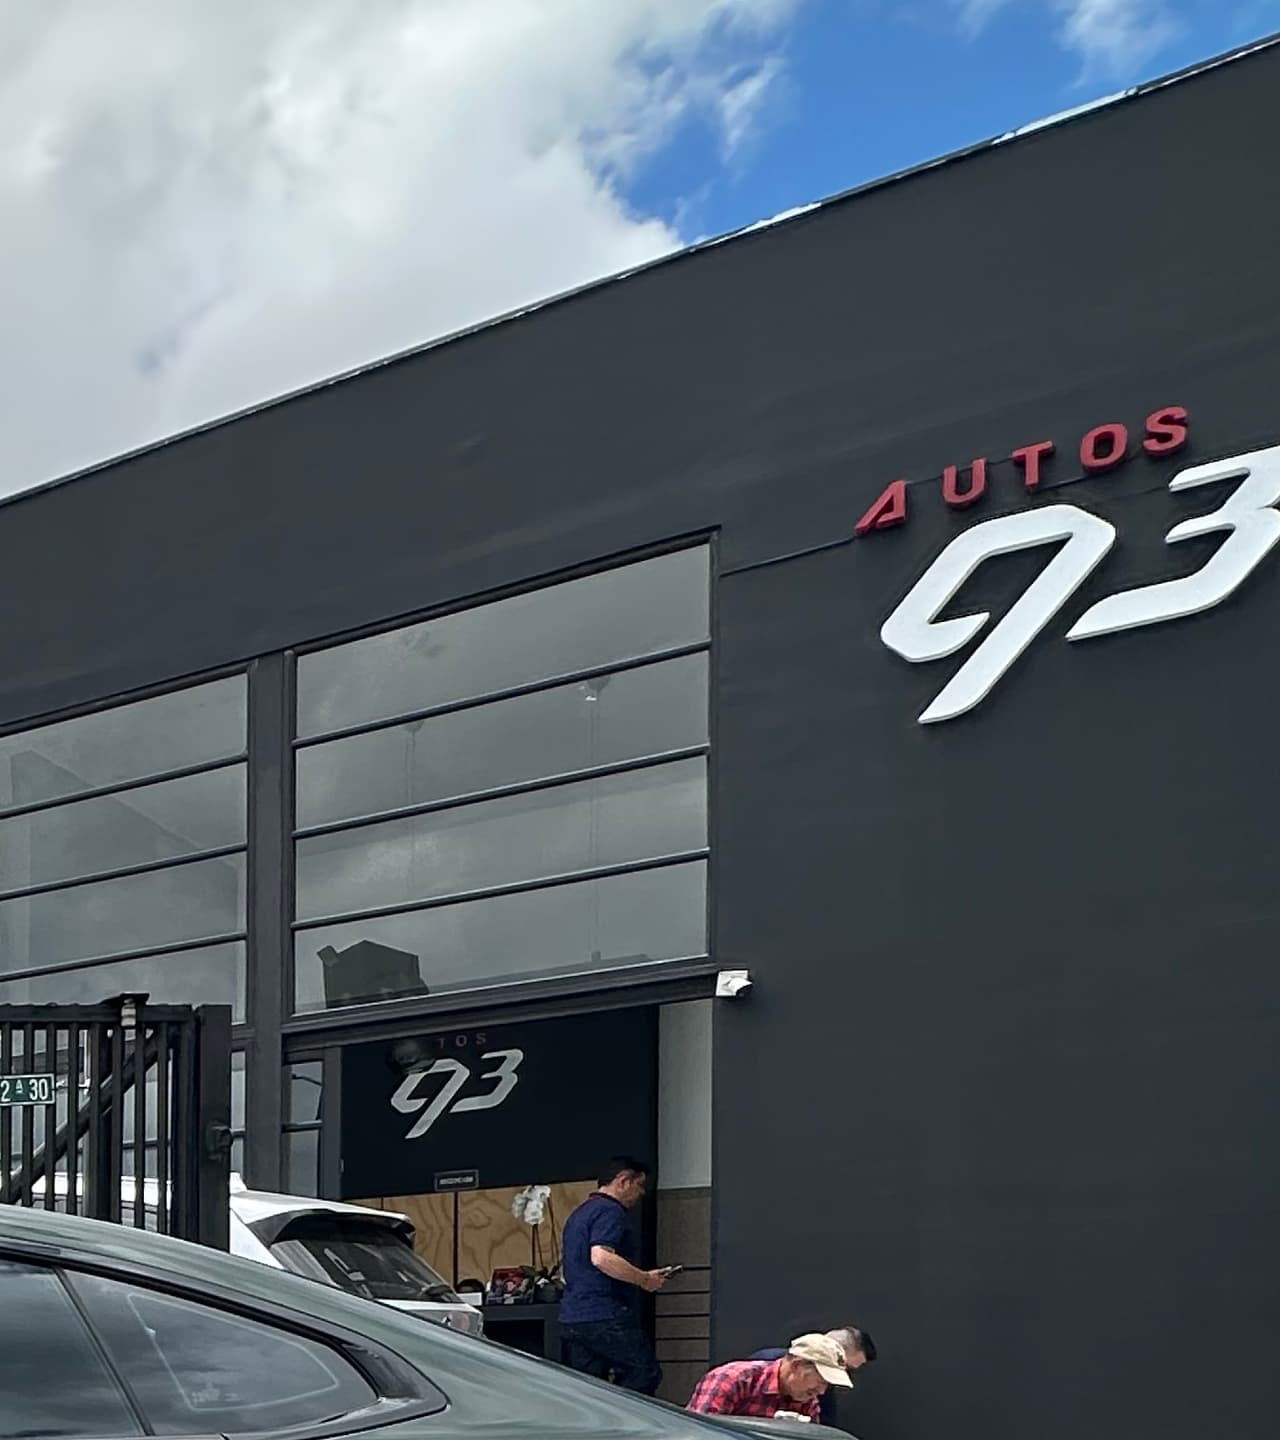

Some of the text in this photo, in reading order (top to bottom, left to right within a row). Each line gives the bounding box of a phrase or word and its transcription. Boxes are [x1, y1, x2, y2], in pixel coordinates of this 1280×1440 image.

[855, 407, 1188, 537] AUTOS
[880, 445, 1280, 725] 93
[436, 1032, 487, 1049] TOS
[29, 1078, 48, 1101] 30
[390, 1048, 524, 1139] 93
